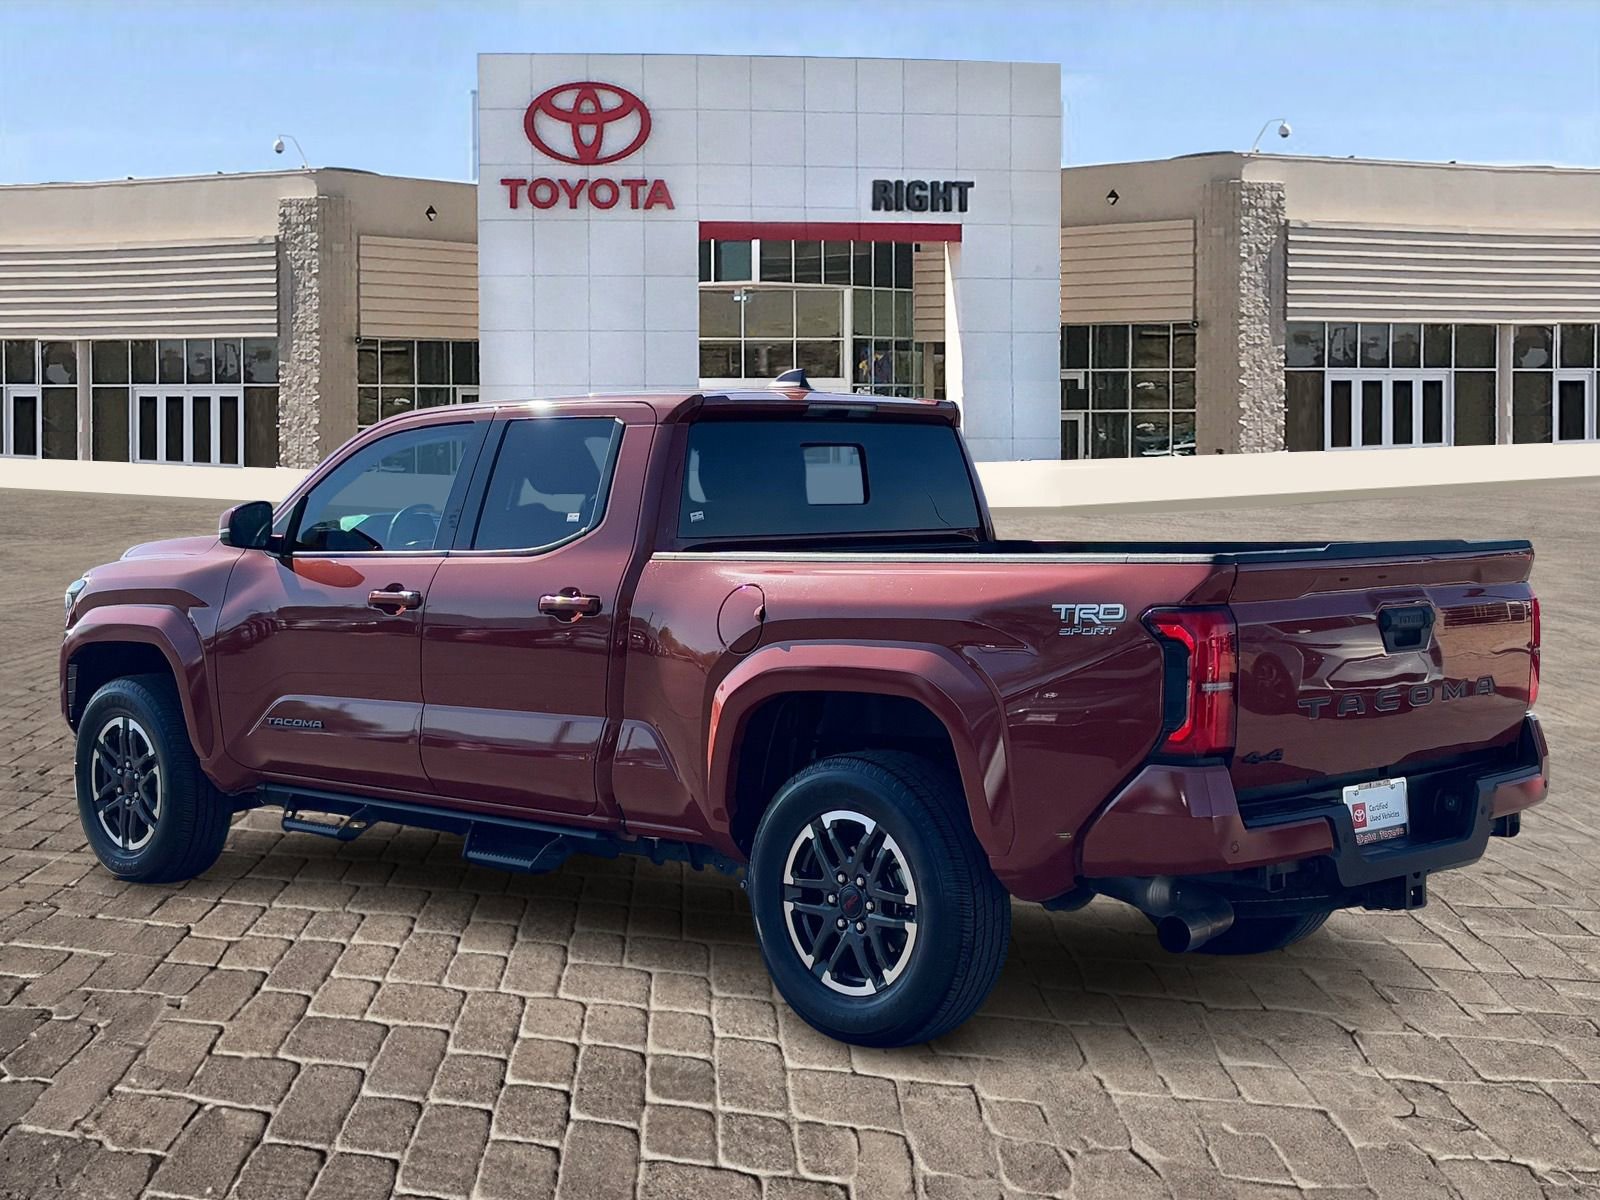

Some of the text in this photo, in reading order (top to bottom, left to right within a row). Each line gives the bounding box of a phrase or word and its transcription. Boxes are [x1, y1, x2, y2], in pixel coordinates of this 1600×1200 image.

[500, 177, 676, 210] TOYOTA
[872, 179, 975, 212] RIGHT
[1051, 603, 1127, 624] TRD
[1058, 625, 1117, 636] SPORT
[1297, 674, 1496, 720] TACOMA
[265, 716, 325, 729] TACOMA
[1368, 801, 1389, 812] Certified
[1369, 810, 1400, 822] Used Vehicles
